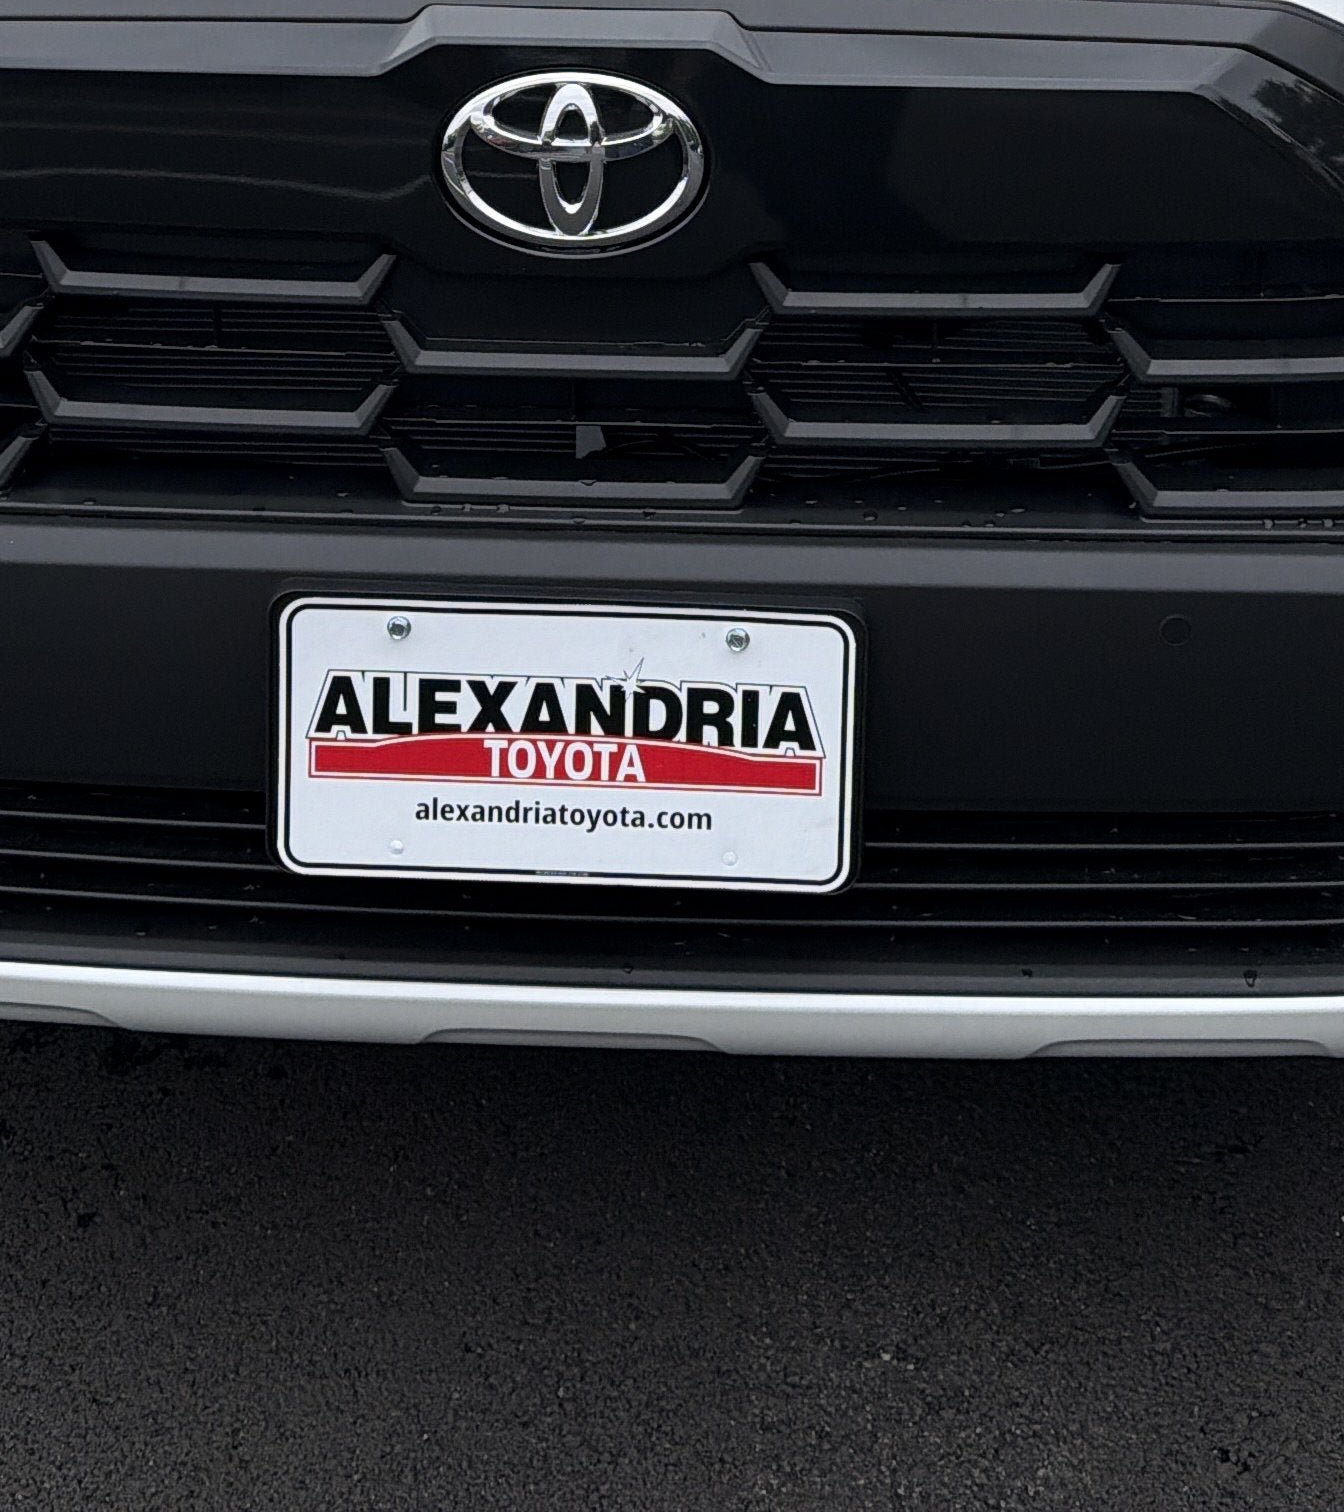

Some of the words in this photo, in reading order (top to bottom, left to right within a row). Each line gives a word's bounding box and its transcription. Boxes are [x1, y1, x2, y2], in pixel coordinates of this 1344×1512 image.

[314, 674, 816, 752] ALEXANDRIA
[483, 738, 647, 783] TOYOTA
[414, 798, 713, 832] alexandriatoyota.com
